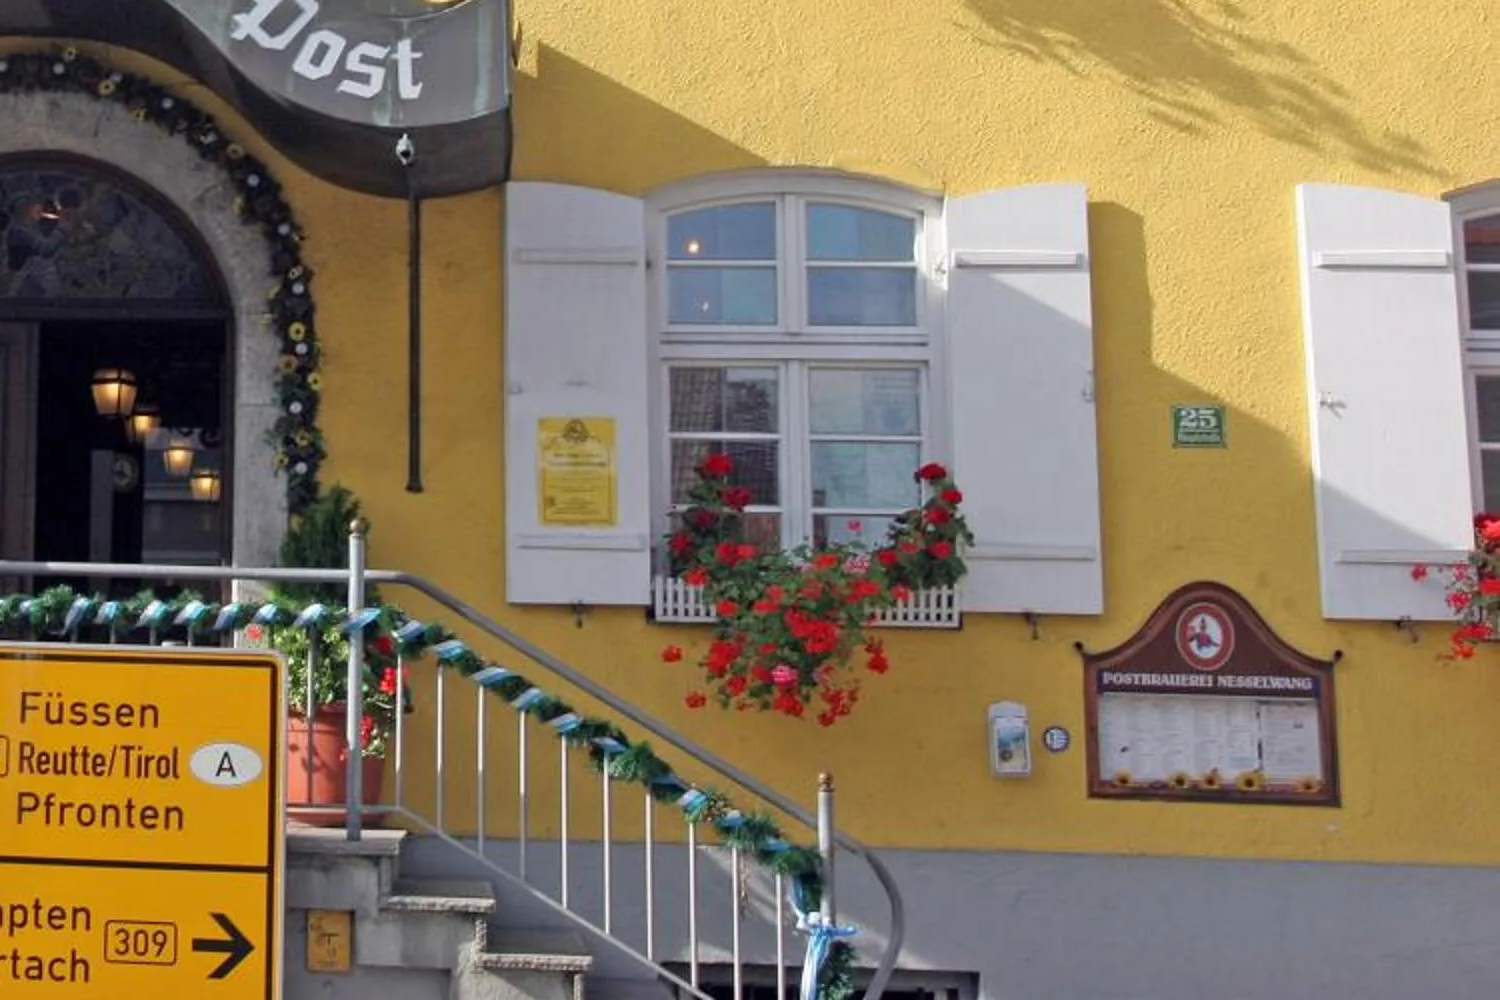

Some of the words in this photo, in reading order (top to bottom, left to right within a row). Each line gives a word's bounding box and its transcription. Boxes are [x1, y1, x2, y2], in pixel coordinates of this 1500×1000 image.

[1179, 408, 1217, 429] 25
[1102, 671, 1213, 688] POSTBRAUEREI
[1217, 674, 1313, 691] NESSELWANG
[19, 691, 160, 729] Füssen
[18, 741, 180, 780] Reutte/Tirol
[215, 751, 237, 778] A
[17, 792, 184, 830] Pfronten
[114, 929, 168, 957] 309
